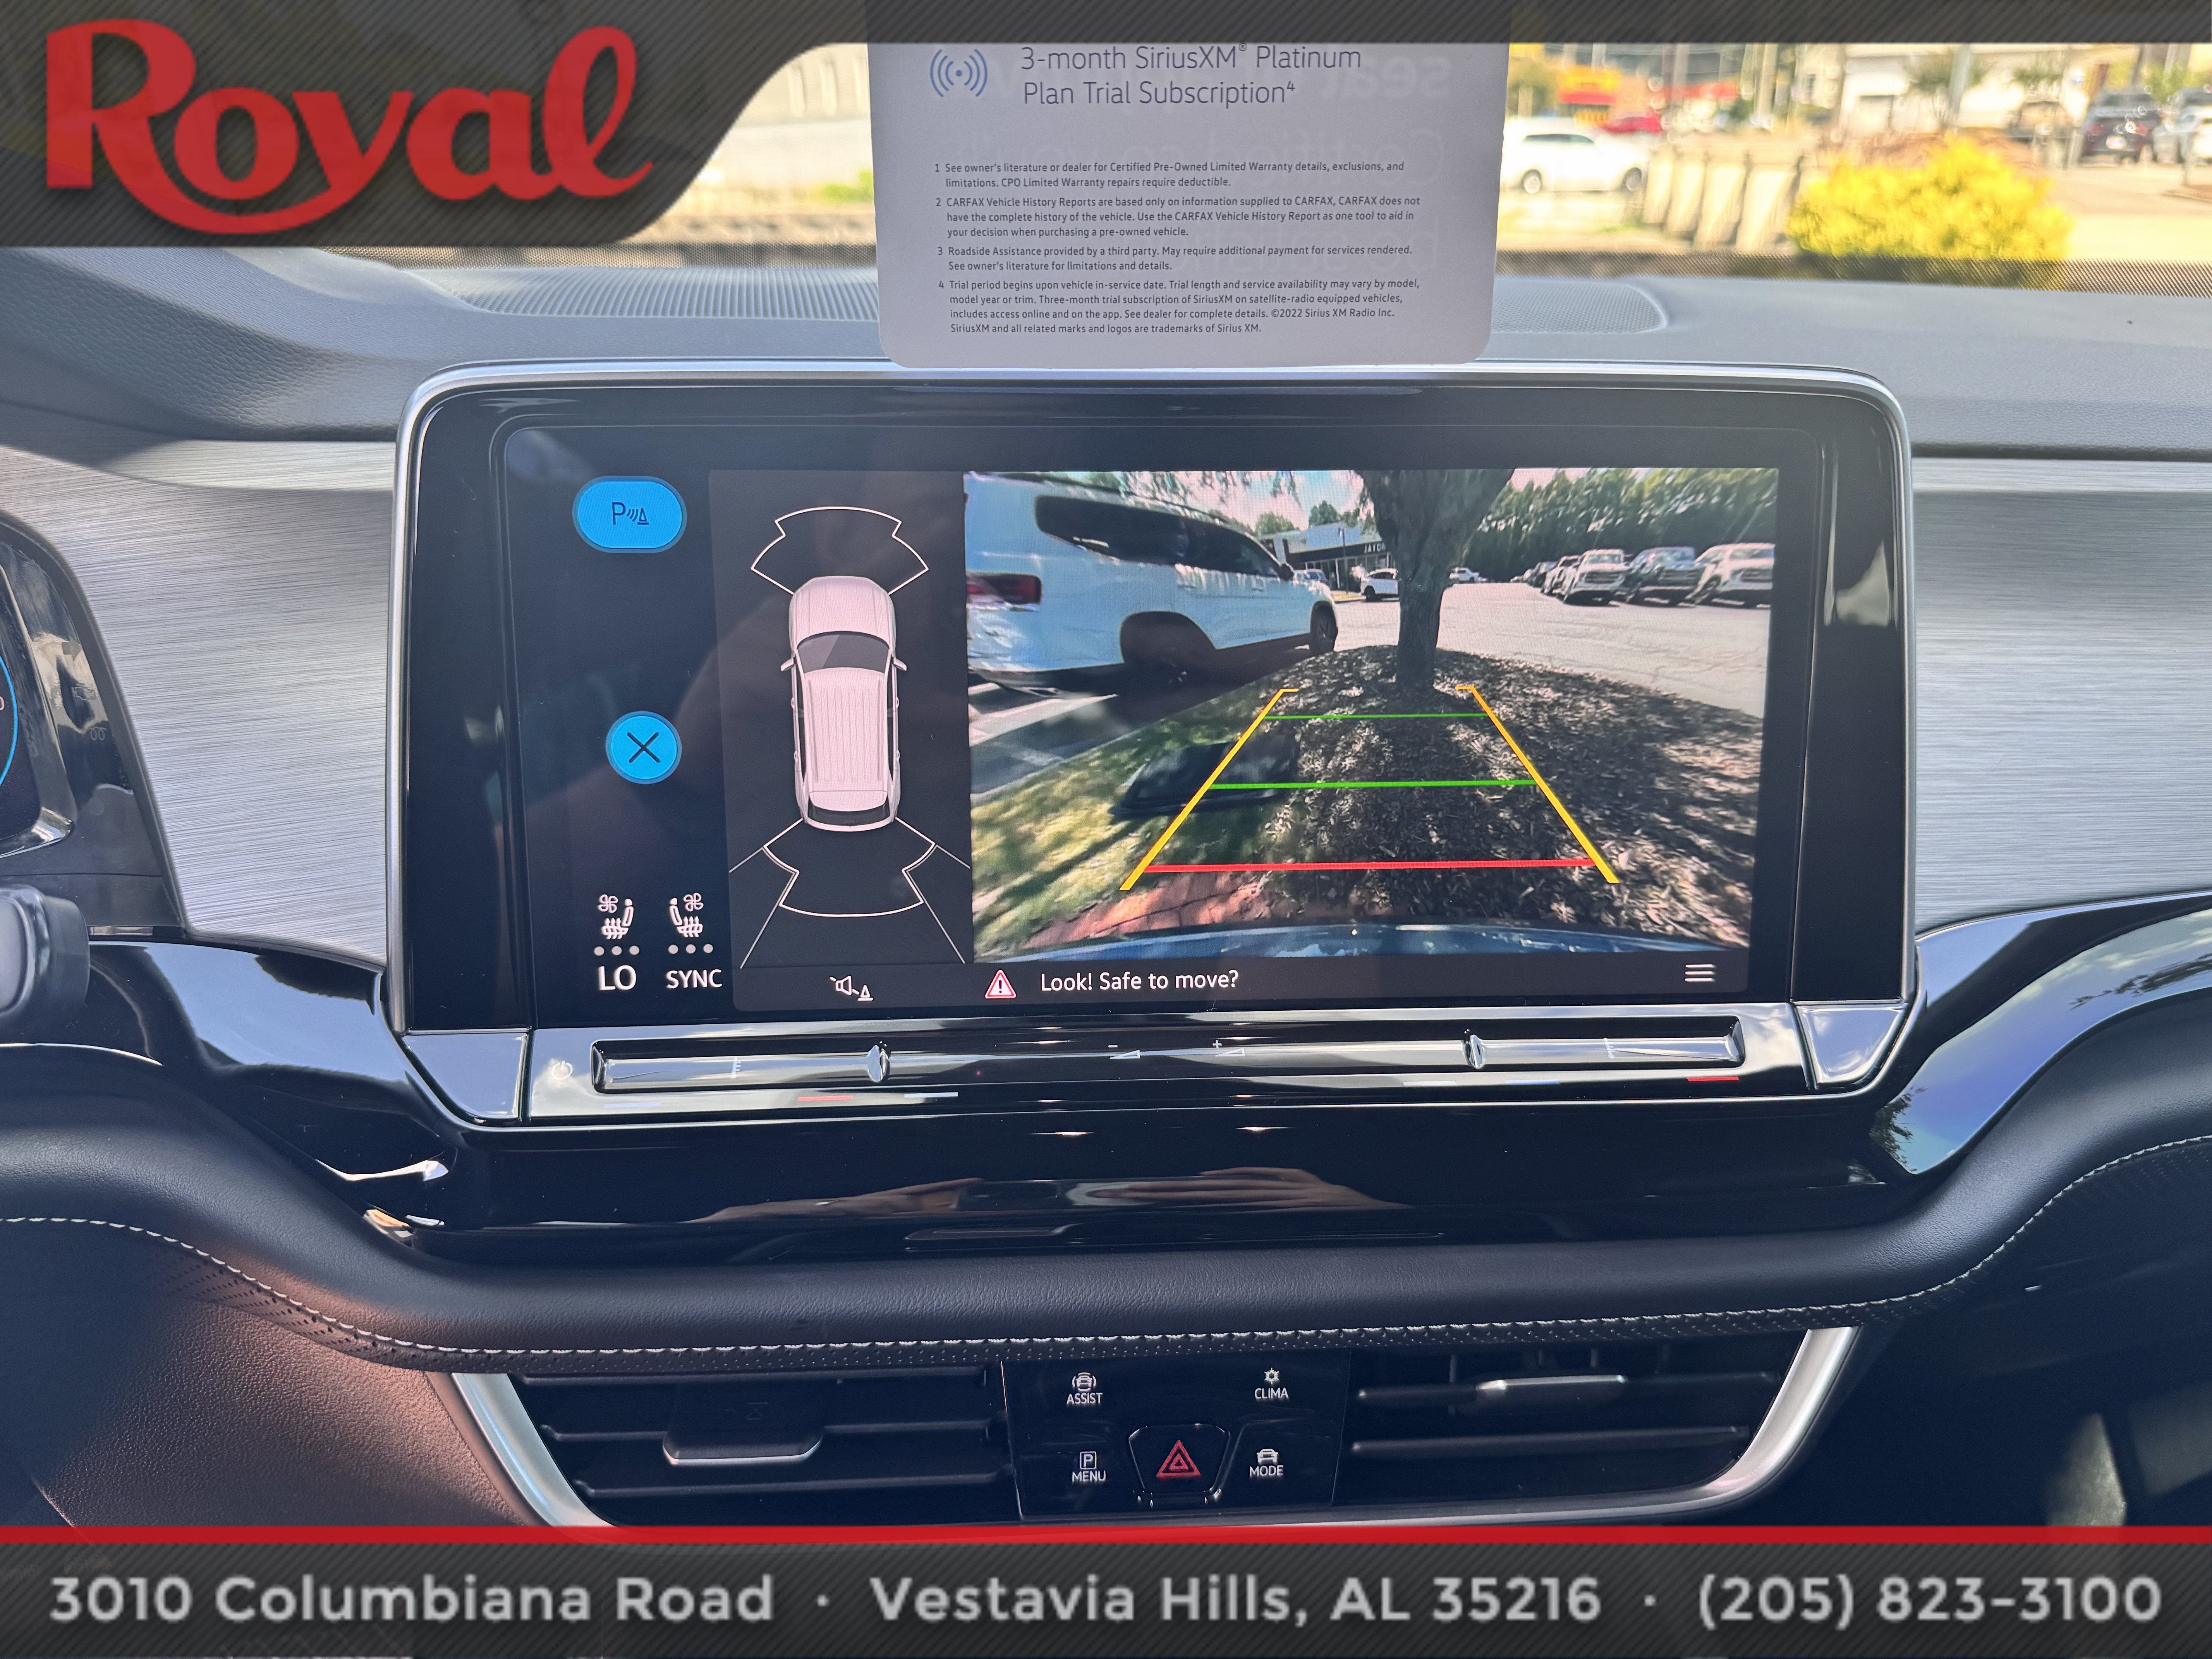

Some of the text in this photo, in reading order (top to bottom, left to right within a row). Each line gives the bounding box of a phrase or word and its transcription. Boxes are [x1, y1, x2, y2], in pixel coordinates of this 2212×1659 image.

[1021, 46, 1126, 70] 3-month
[1256, 46, 1361, 69] Platinum
[1024, 81, 1074, 105] Plan
[1082, 81, 1131, 104] Trial
[935, 163, 940, 172] 1
[945, 163, 962, 172] See
[964, 163, 1001, 172] owner's
[1004, 163, 1048, 172] literature
[1062, 162, 1092, 172] dealer
[1094, 162, 1108, 172] for
[1110, 162, 1151, 172] Certified
[1154, 162, 1207, 171] Pre-Owned
[1210, 161, 1246, 171] Limited
[1249, 162, 1293, 173] Warranty
[1295, 161, 1330, 172] details,
[1332, 161, 1384, 172] exclusions,
[1386, 161, 1404, 170] and
[946, 177, 1231, 189] limitations. CPO Limited Warranty repairs require deductible.
[936, 198, 941, 207] 2
[946, 198, 984, 207] CARFAX
[986, 197, 1020, 207] Vehicle
[1022, 198, 1056, 209] History
[1059, 198, 1096, 208] Reports
[1115, 197, 1143, 206] based
[1145, 197, 1166, 208] only
[1182, 196, 1238, 206] information
[1240, 196, 1280, 208] supplied
[1283, 198, 1292, 206] to
[1295, 196, 1336, 207] CARFAX,
[1338, 196, 1377, 205] CARFAX
[1379, 196, 1402, 205] does
[1404, 197, 1420, 205] not
[947, 229, 968, 239] your
[970, 227, 1008, 237] decision
[1010, 227, 1036, 236] when
[1039, 227, 1089, 239] purchasing
[1099, 227, 1151, 238] pre-owned
[1153, 227, 1189, 236] vehicle.
[938, 246, 943, 256] 3
[948, 246, 990, 256] Roadside
[993, 246, 1041, 256] Assistance
[1044, 246, 1084, 258] provided
[1087, 246, 1097, 258] by
[1108, 246, 1130, 256] third
[1132, 247, 1159, 258] party.
[1162, 246, 1181, 258] May
[1183, 246, 1216, 257] require
[1218, 246, 1266, 255] additional
[1267, 247, 1309, 257] payment
[1311, 245, 1325, 254] for
[1327, 245, 1365, 254] services
[1367, 245, 1412, 254] rendered.
[949, 261, 1172, 270] See owner's literature for limitations and details.
[938, 279, 1419, 292] 4 Trial period begins upon vehicle in-service date. Trial length and service availability may vary by model,
[950, 295, 978, 304] model
[981, 297, 1001, 306] year
[1014, 295, 1036, 304] trim.
[1039, 295, 1099, 304] Three-month
[1102, 295, 1120, 304] trial
[1123, 295, 1179, 306] subscription
[1181, 294, 1191, 304] of
[1193, 294, 1233, 304] SiriusXM
[1249, 294, 1315, 303] satellite-radio
[1317, 294, 1360, 305] equipped
[1362, 293, 1402, 304] vehicles,
[950, 309, 988, 318] includes
[1022, 309, 1050, 319] online
[1052, 309, 1069, 318] and
[1085, 309, 1101, 319] the
[1103, 312, 1122, 320] app.
[1125, 309, 1141, 318] See
[1143, 309, 1172, 318] dealer
[1174, 309, 1187, 318] for
[1190, 309, 1232, 320] complete
[1235, 309, 1269, 318] details.
[1271, 308, 1302, 318] ©2022
[1305, 308, 1330, 318] Sirius
[1332, 308, 1346, 317] XM
[1349, 308, 1376, 317] Radio
[1378, 308, 1395, 317] Inc.
[951, 324, 989, 333] SiriusXM
[992, 324, 1008, 333] and
[1011, 323, 1021, 333] all
[1024, 324, 1056, 333] related
[1058, 324, 1086, 333] marks
[1088, 324, 1105, 333] and
[1108, 324, 1132, 335] logos
[1151, 323, 1203, 333] trademarks
[1205, 323, 1215, 333] of
[1217, 323, 1242, 333] Sirius
[1244, 323, 1262, 332] XM.
[598, 965, 637, 991] LO
[666, 969, 723, 989] SYNC
[1041, 969, 1238, 991] Look! Safe to move?
[1066, 1392, 1103, 1405] ASSIST
[1254, 1387, 1289, 1399] CLIMA
[1072, 1470, 1106, 1482] MENU
[1249, 1465, 1283, 1477] MODE
